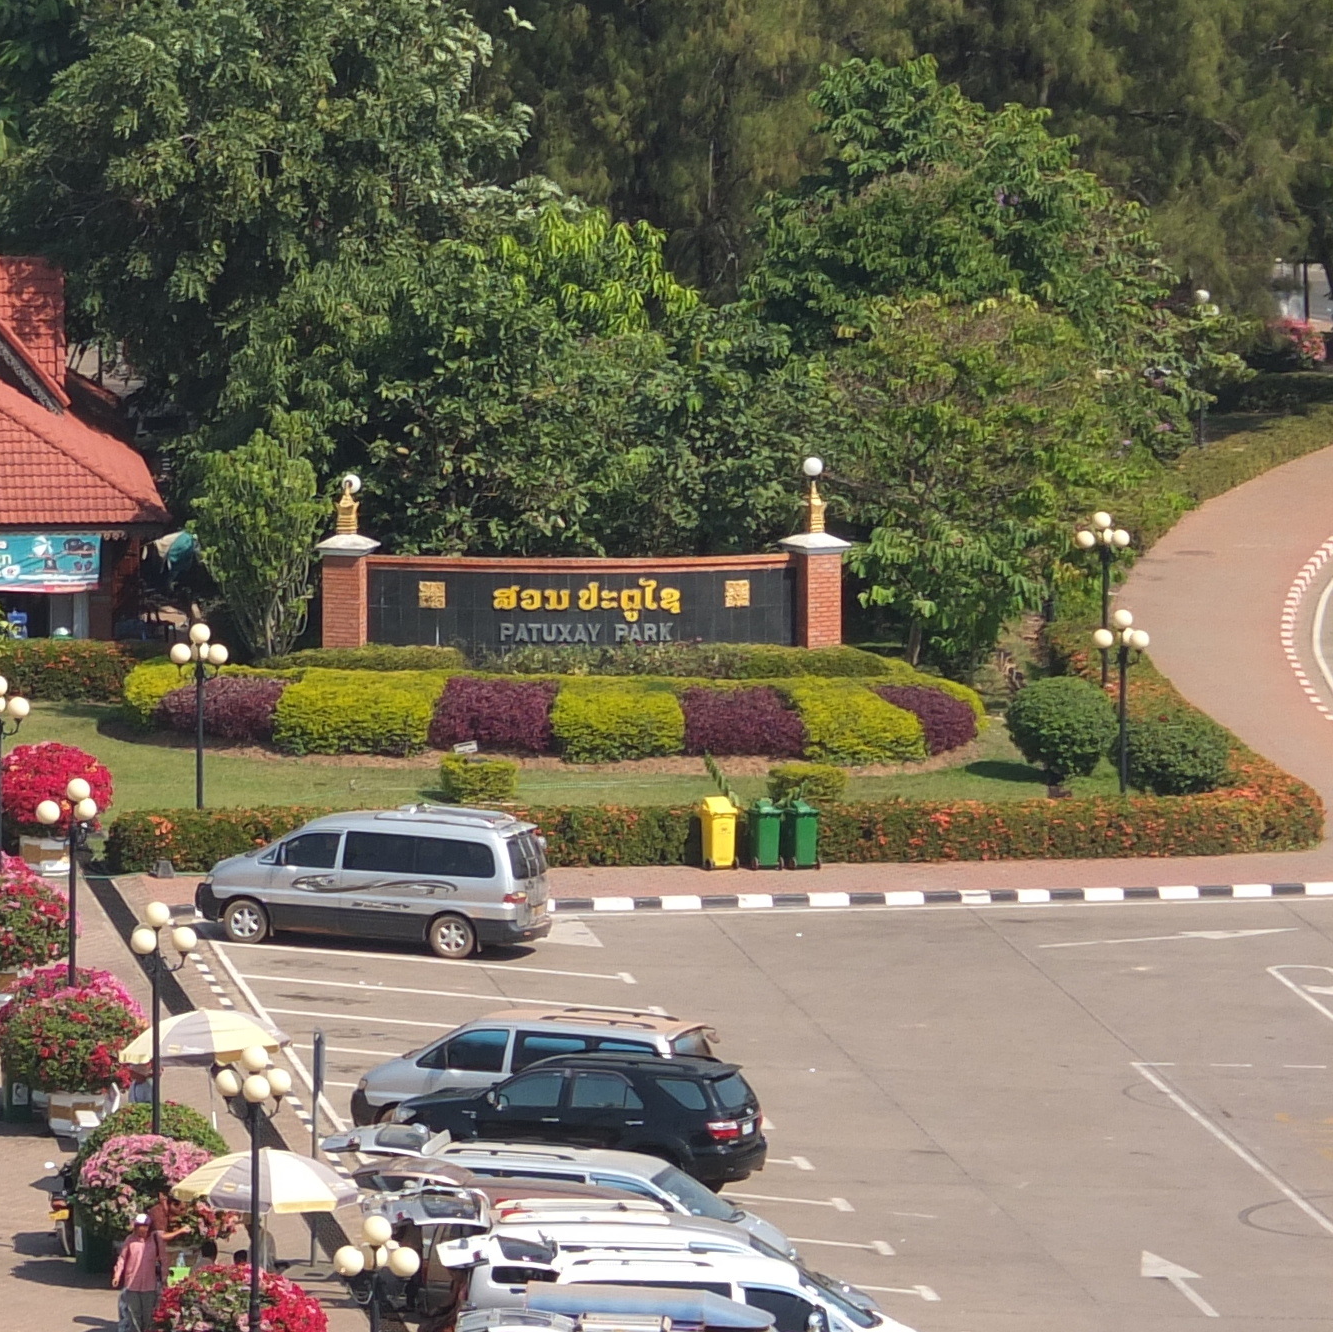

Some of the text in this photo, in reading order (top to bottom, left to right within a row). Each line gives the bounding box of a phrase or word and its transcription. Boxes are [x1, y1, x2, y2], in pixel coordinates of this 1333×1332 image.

[493, 585, 571, 610] ສວນ
[499, 622, 674, 643] PATUXAY PARK
